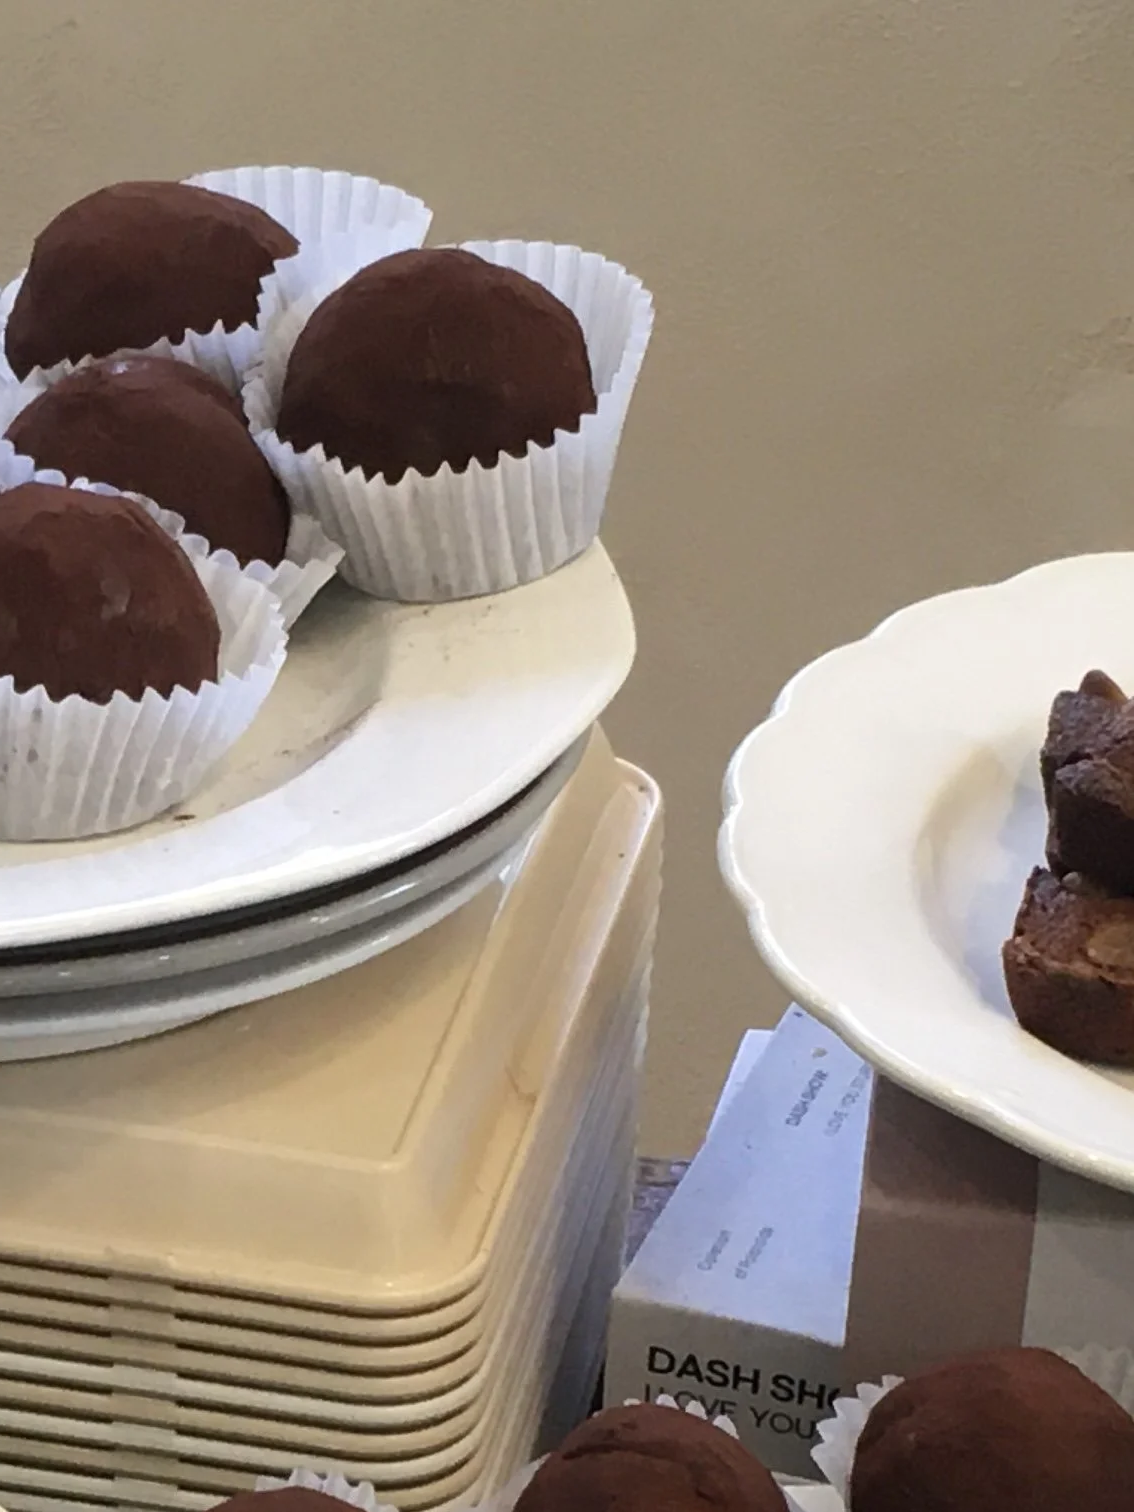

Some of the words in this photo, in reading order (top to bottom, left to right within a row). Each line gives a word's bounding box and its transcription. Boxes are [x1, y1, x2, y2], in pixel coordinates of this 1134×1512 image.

[647, 1345, 761, 1395] DASH
[657, 1386, 737, 1417] OVE
[749, 1405, 817, 1440] YOU
